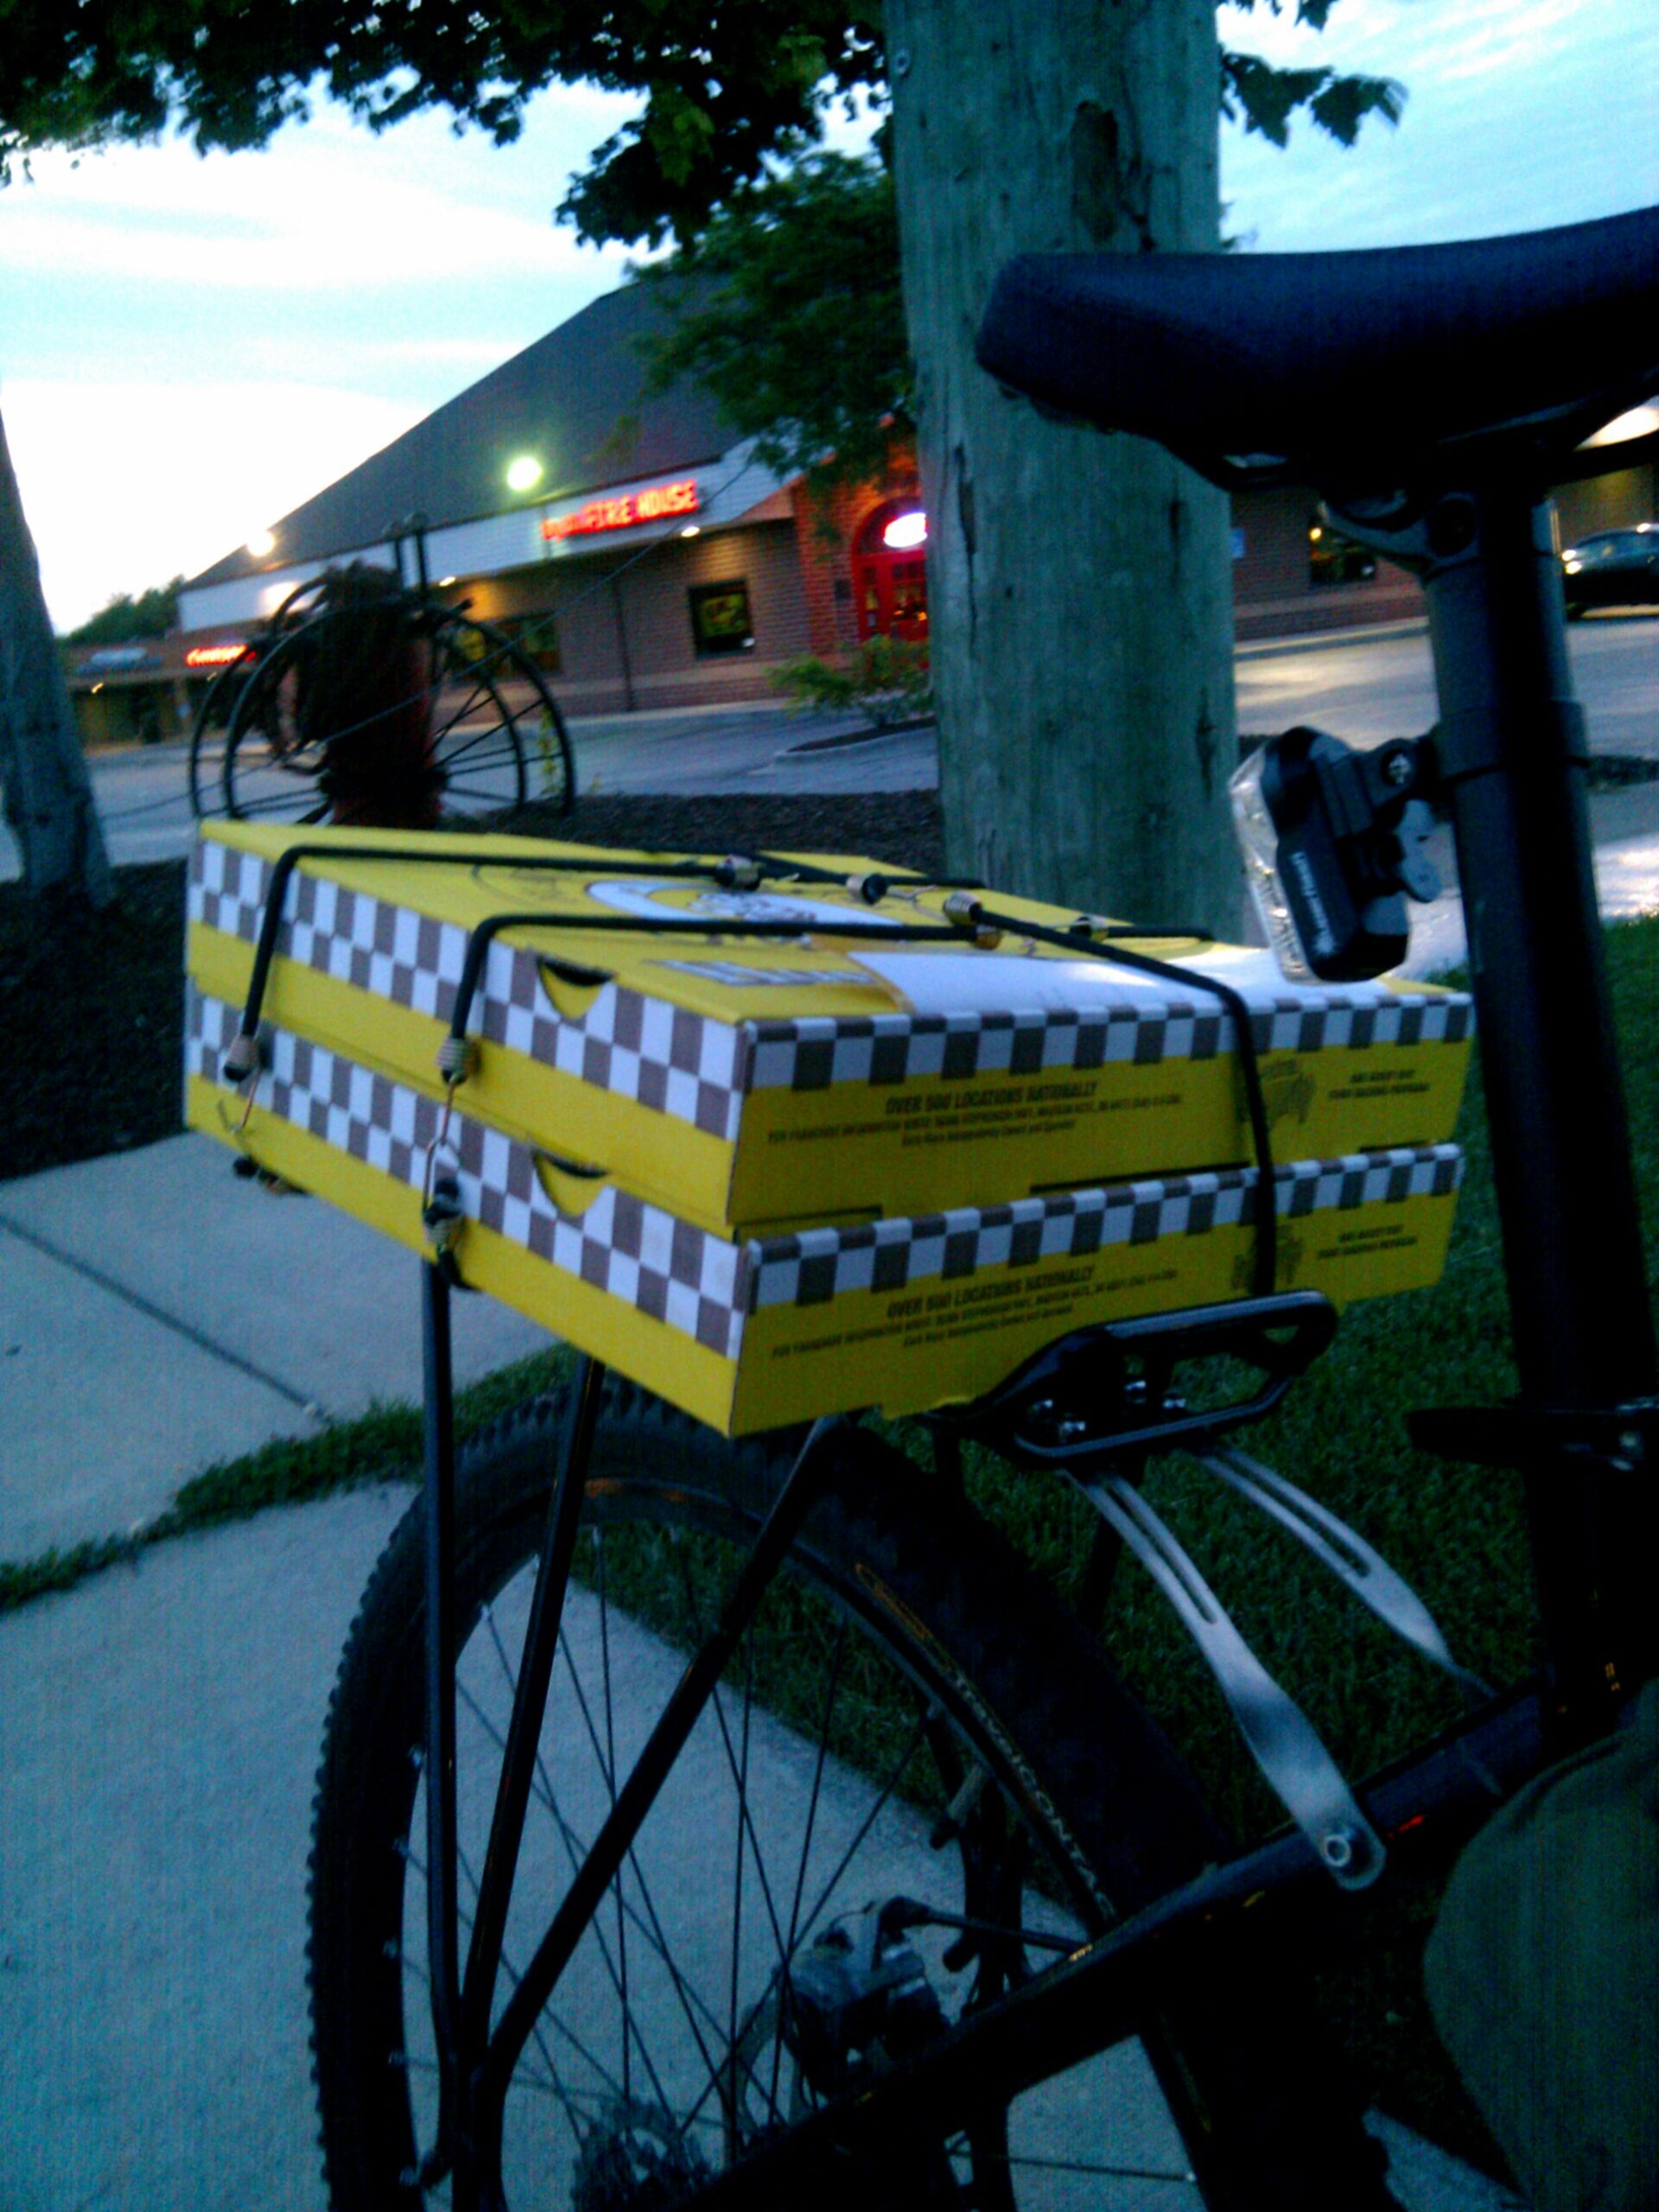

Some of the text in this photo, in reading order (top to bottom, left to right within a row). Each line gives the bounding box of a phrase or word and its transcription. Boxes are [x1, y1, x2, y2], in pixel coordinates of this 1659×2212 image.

[636, 479, 699, 523] HOUSE
[886, 1094, 923, 1115] OVER
[954, 1086, 1023, 1109] LOCATIONS
[1026, 1080, 1097, 1103] NATIONALLY
[887, 1297, 923, 1319] OVER
[954, 1279, 1022, 1306] LOCATIONS
[1025, 1265, 1095, 1292] NATIONALLY
